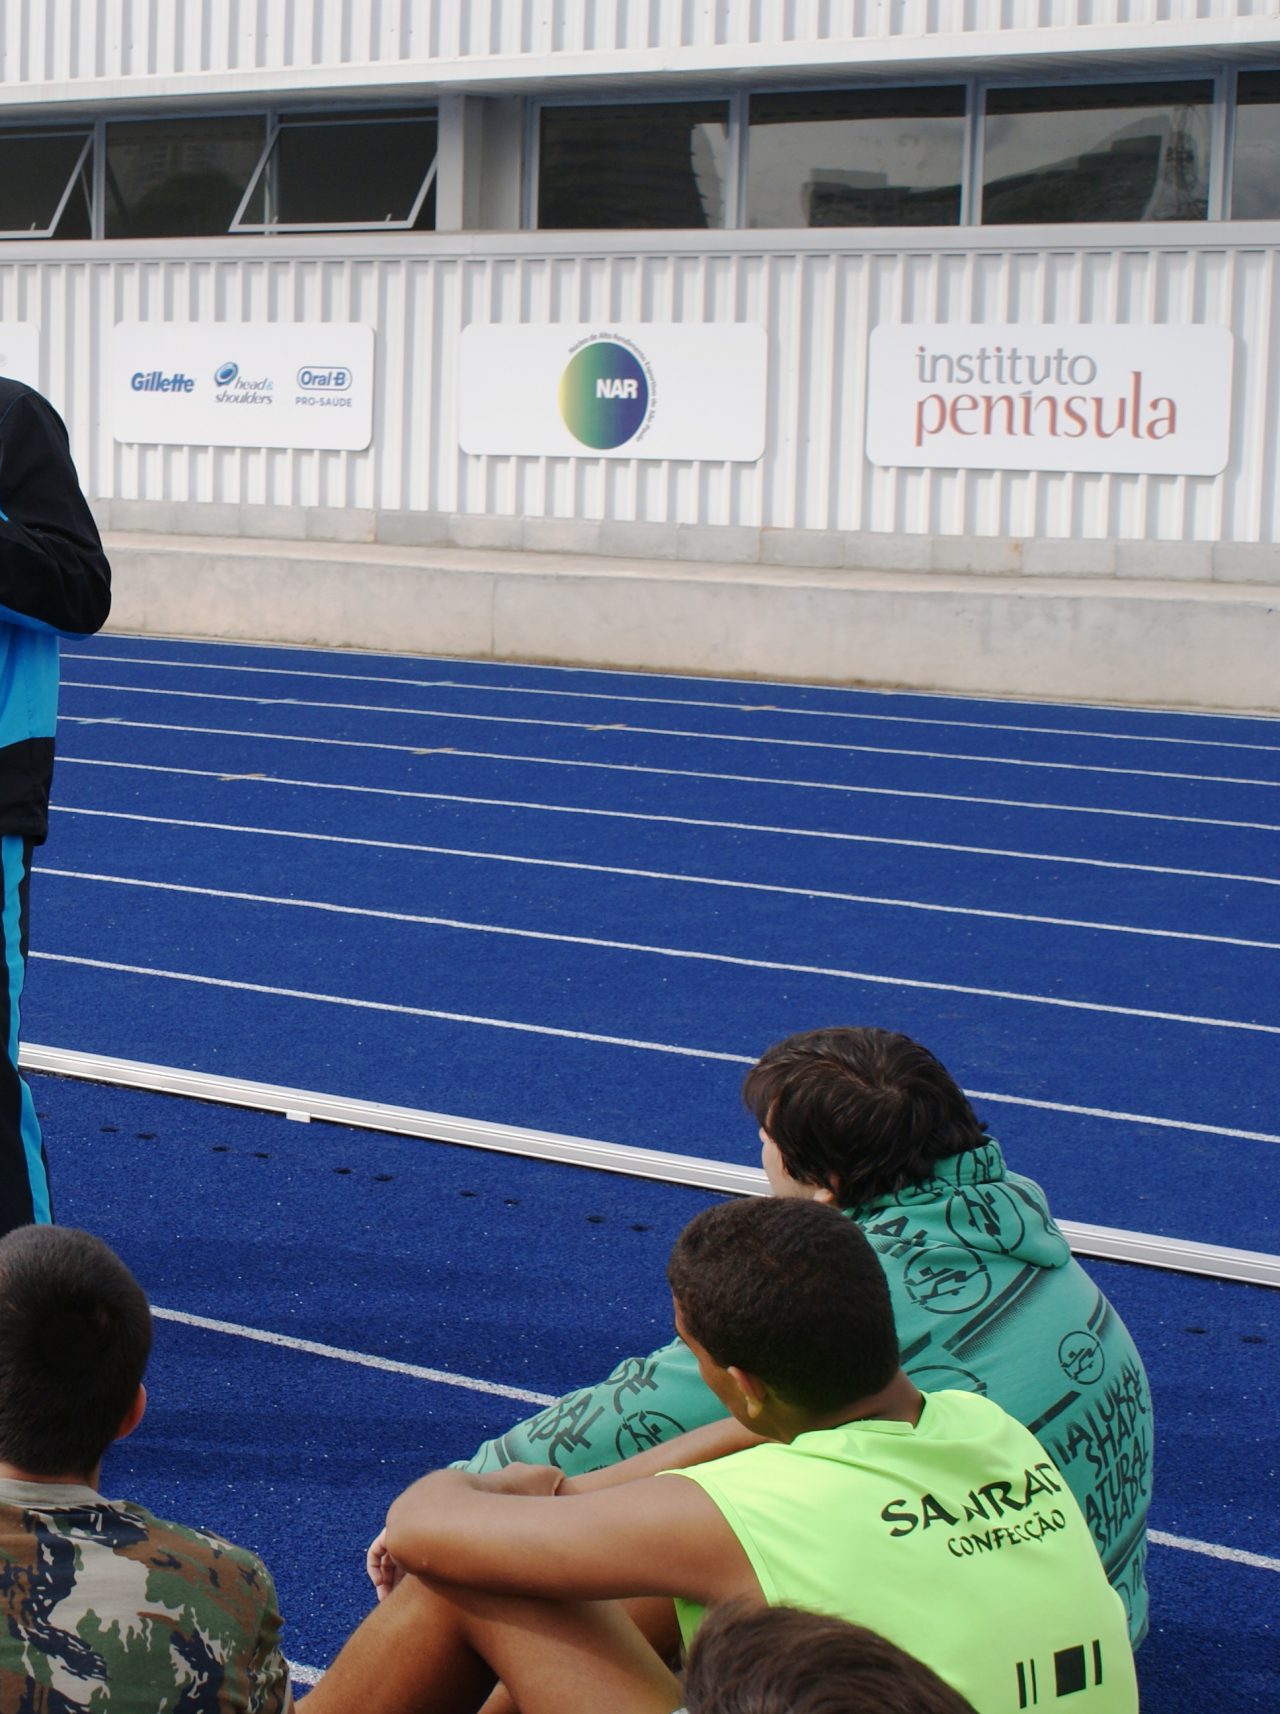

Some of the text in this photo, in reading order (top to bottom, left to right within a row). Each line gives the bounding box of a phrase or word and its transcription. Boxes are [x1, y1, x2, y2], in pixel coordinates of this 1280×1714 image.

[915, 346, 1098, 386] instituto
[131, 371, 195, 393] Gillette
[300, 370, 346, 386] Oral-B
[595, 378, 639, 399] NAR
[215, 390, 273, 405] shoulders
[914, 371, 1177, 447] península
